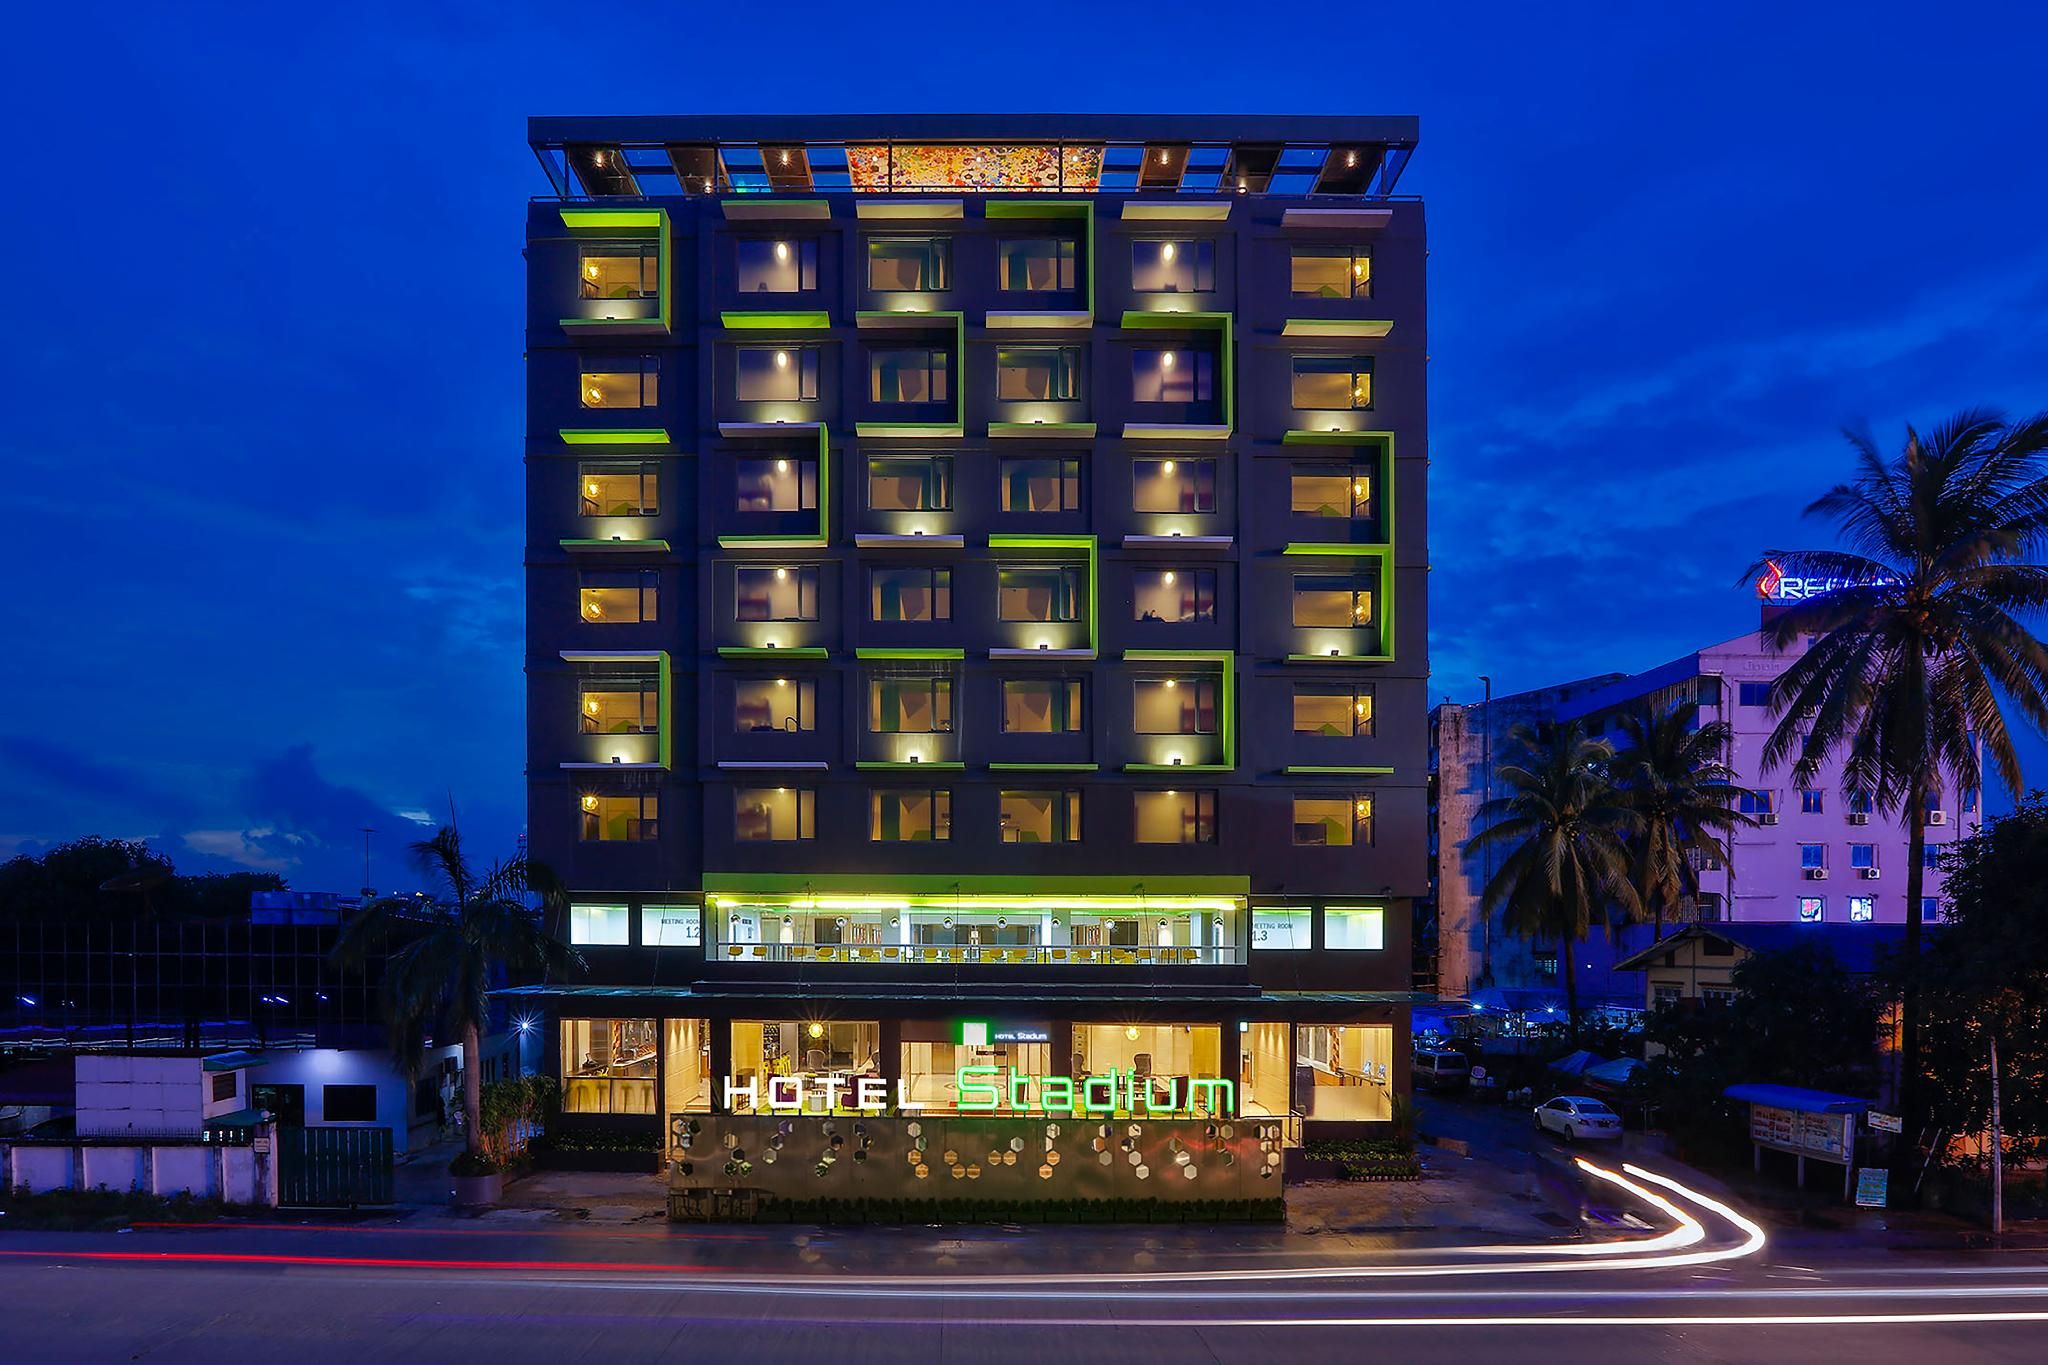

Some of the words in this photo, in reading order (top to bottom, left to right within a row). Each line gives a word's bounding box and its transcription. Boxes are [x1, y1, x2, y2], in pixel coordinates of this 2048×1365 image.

[1277, 922, 1294, 930] ROOM
[686, 926, 700, 939] 1.2
[1252, 930, 1268, 942] 1.3
[1017, 1031, 1048, 1041] Stadium
[723, 1075, 925, 1110] HOTEL
[956, 1065, 1235, 1113] Stadium
